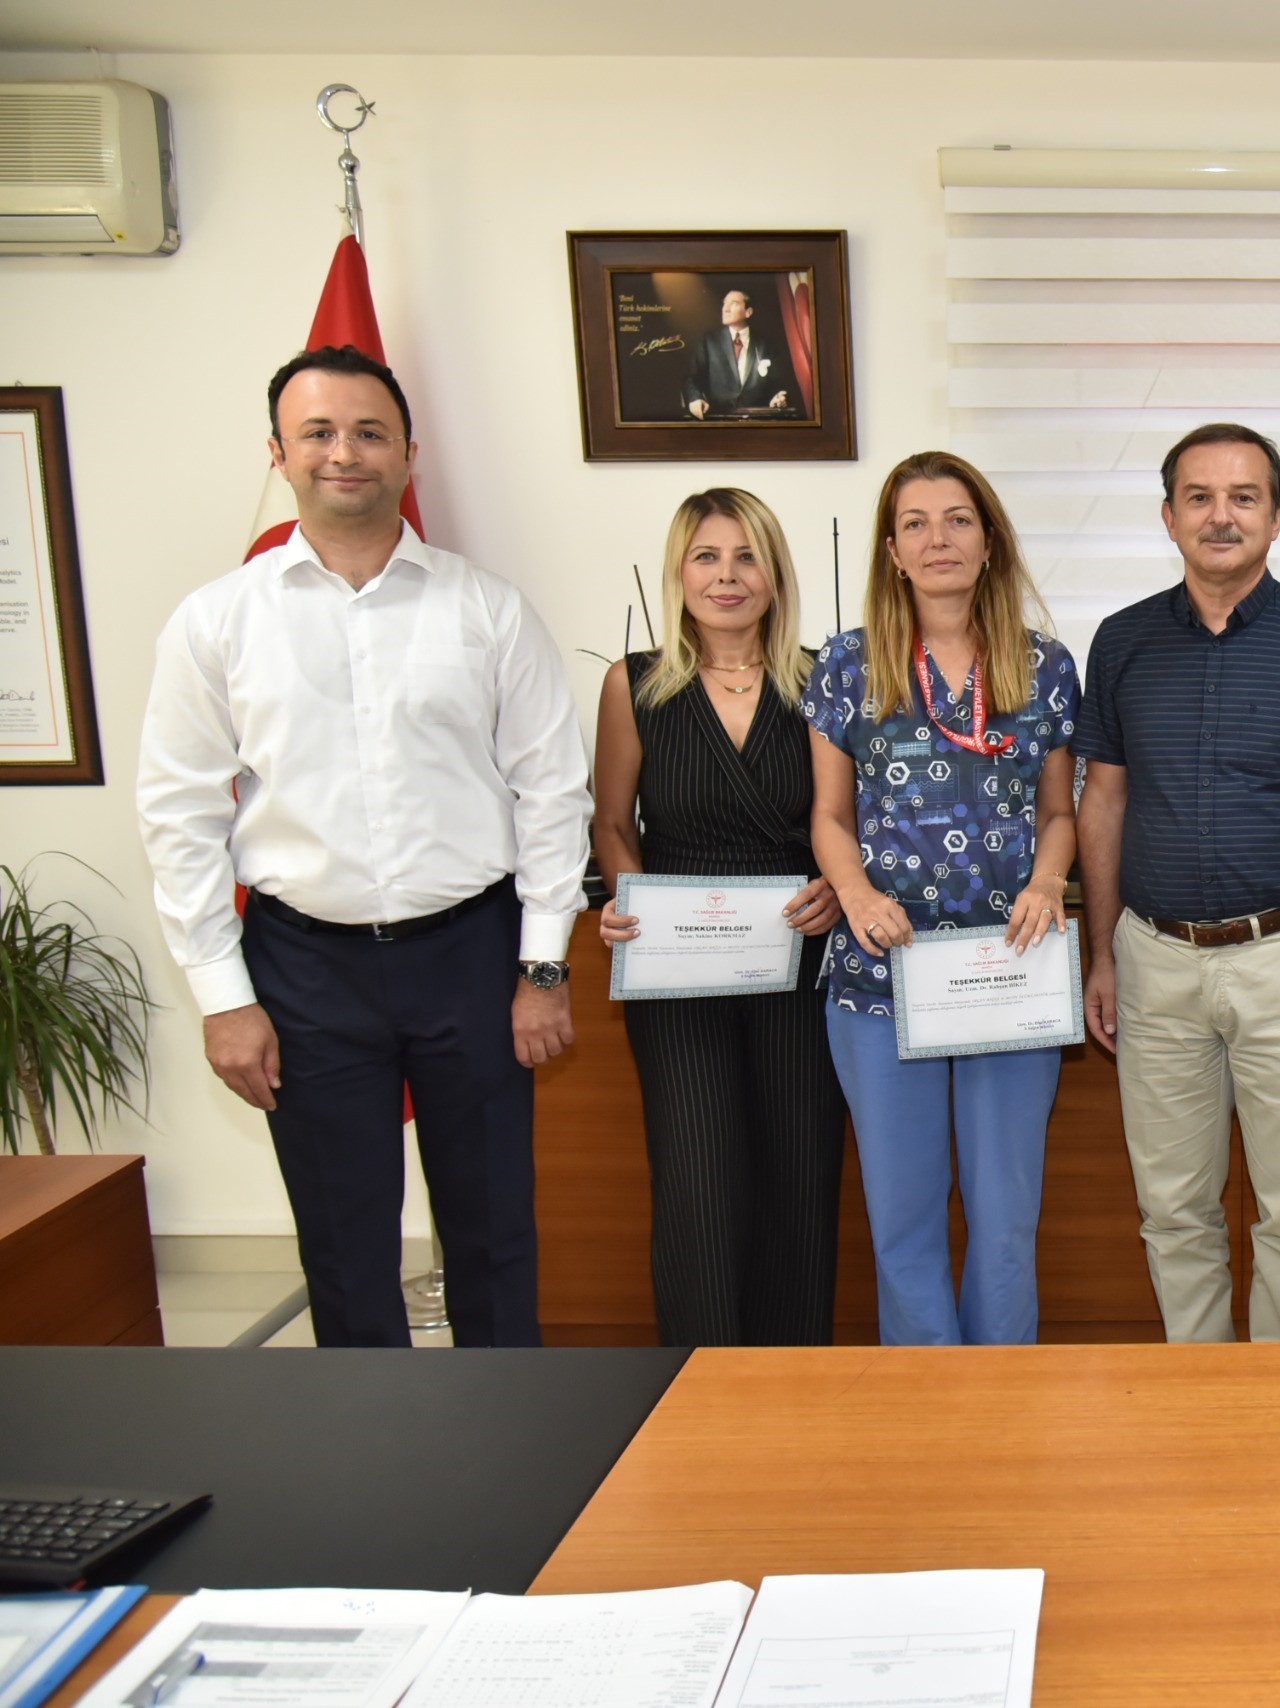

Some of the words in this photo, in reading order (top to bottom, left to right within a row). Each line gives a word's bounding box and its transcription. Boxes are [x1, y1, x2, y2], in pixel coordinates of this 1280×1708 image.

[974, 687, 983, 714] DEVLET
[950, 977, 991, 986] TEŞEKKÜR
[994, 973, 1027, 982] BELGESİ
